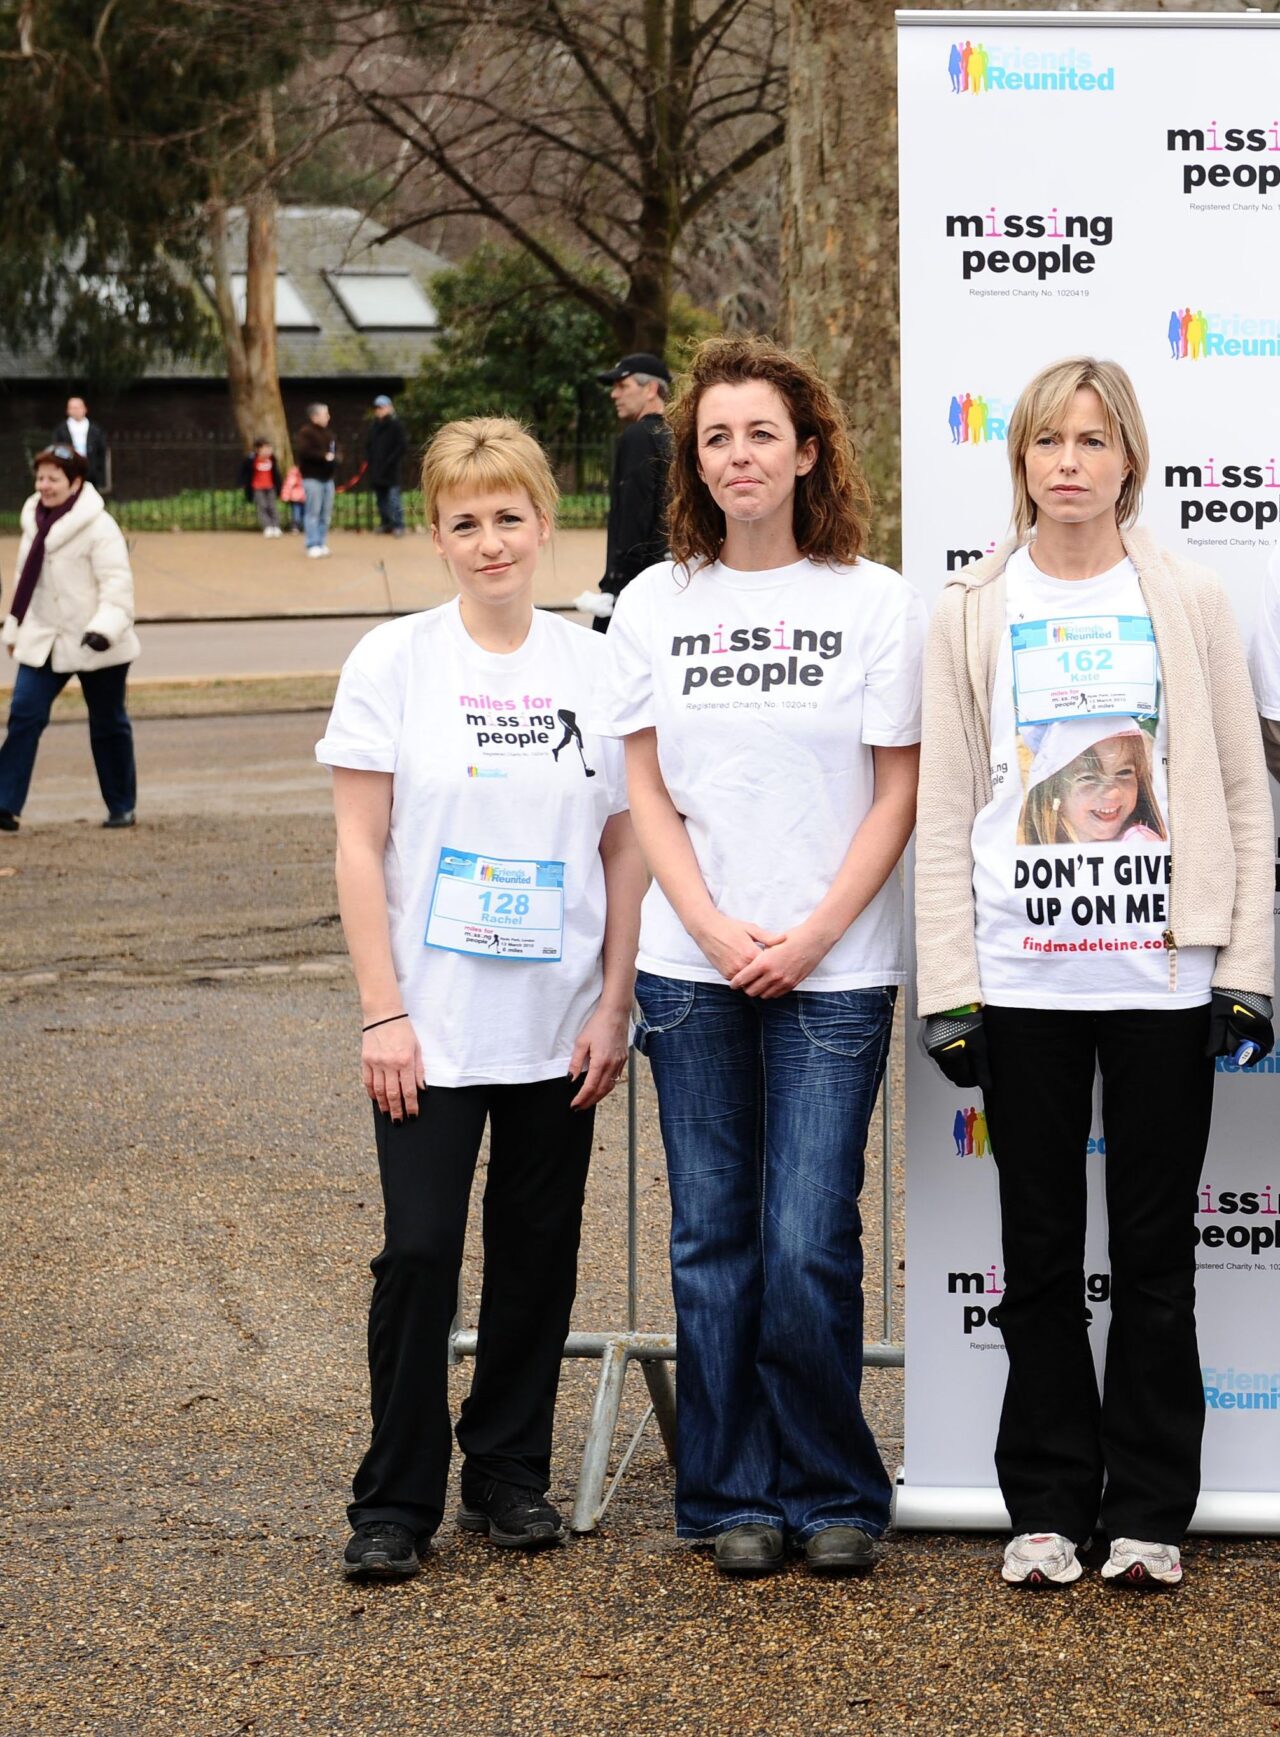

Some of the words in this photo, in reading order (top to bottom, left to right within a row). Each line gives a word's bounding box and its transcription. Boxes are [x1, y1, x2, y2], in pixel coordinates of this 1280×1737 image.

[987, 46, 1092, 70] Friends
[986, 66, 1115, 91] Reunited
[1189, 203, 1231, 211] Registered
[1232, 203, 1259, 212] Charity
[946, 207, 1113, 246] missing
[963, 244, 1095, 280] people
[969, 288, 1010, 297] Registered
[1012, 288, 1039, 297] Charity
[1041, 288, 1053, 296] No.
[1056, 288, 1090, 296] 1020419
[1187, 537, 1228, 546] Registered
[1229, 538, 1256, 547] Charity
[1258, 538, 1271, 546] No.
[671, 620, 842, 660] missing
[1066, 631, 1112, 641] Reunited
[1057, 648, 1114, 673] 162
[682, 656, 824, 695] people
[1071, 671, 1100, 683] Kate
[460, 694, 516, 711] miles
[523, 694, 553, 710] for
[686, 701, 732, 711] Registered
[733, 701, 761, 710] Charity
[781, 701, 818, 709] 1020419
[477, 729, 549, 748] people
[491, 872, 532, 884] Reunited
[494, 866, 526, 877] Friends
[1014, 854, 1104, 890] DON'T
[1114, 855, 1172, 886] GIVE
[478, 891, 530, 916] 128
[1026, 897, 1061, 926] UP
[1071, 895, 1116, 926] ON
[1126, 893, 1166, 923] ME
[481, 913, 522, 925] Rachel
[1195, 1262, 1224, 1271] gistered
[1226, 1262, 1253, 1271] Charity
[1254, 1262, 1267, 1270] No.
[969, 1342, 1006, 1351] Registere
